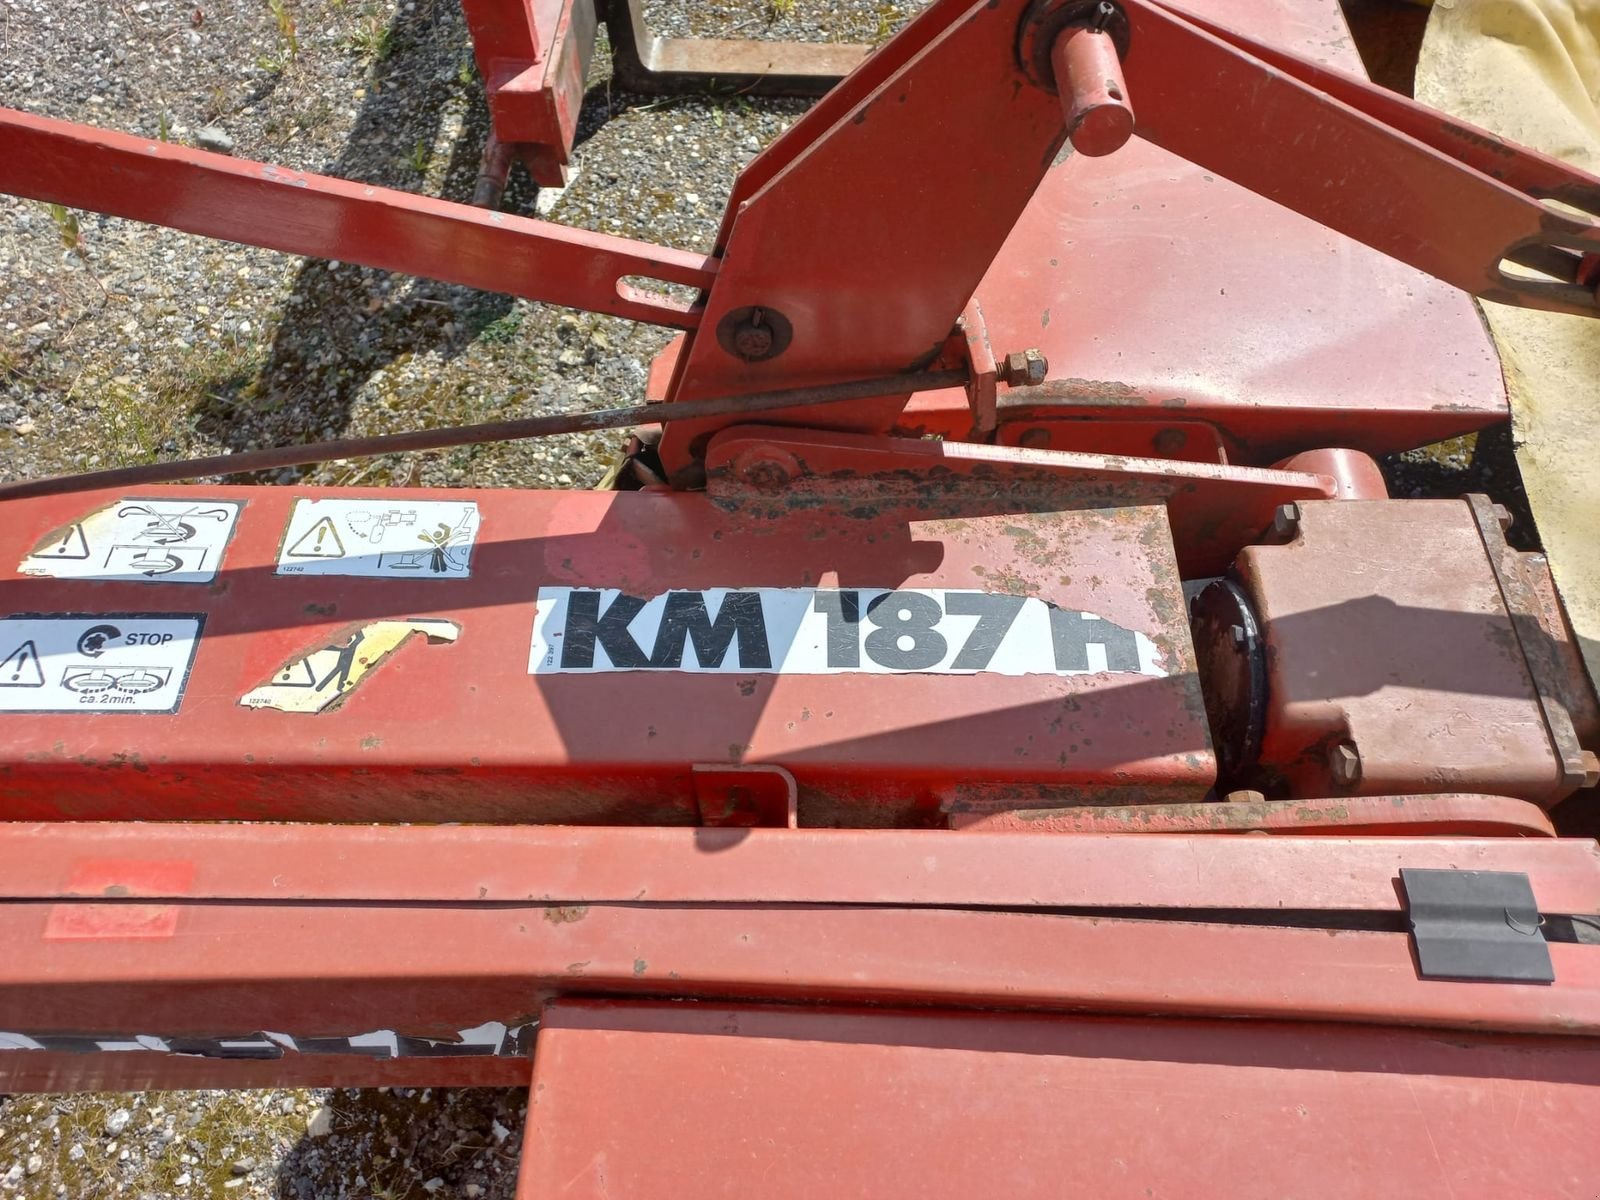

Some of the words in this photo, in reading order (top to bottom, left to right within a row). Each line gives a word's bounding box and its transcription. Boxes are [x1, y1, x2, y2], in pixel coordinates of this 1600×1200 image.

[124, 633, 173, 646] STOP
[560, 591, 772, 668] KM
[814, 591, 1029, 670] 187
[1049, 603, 1141, 671] H
